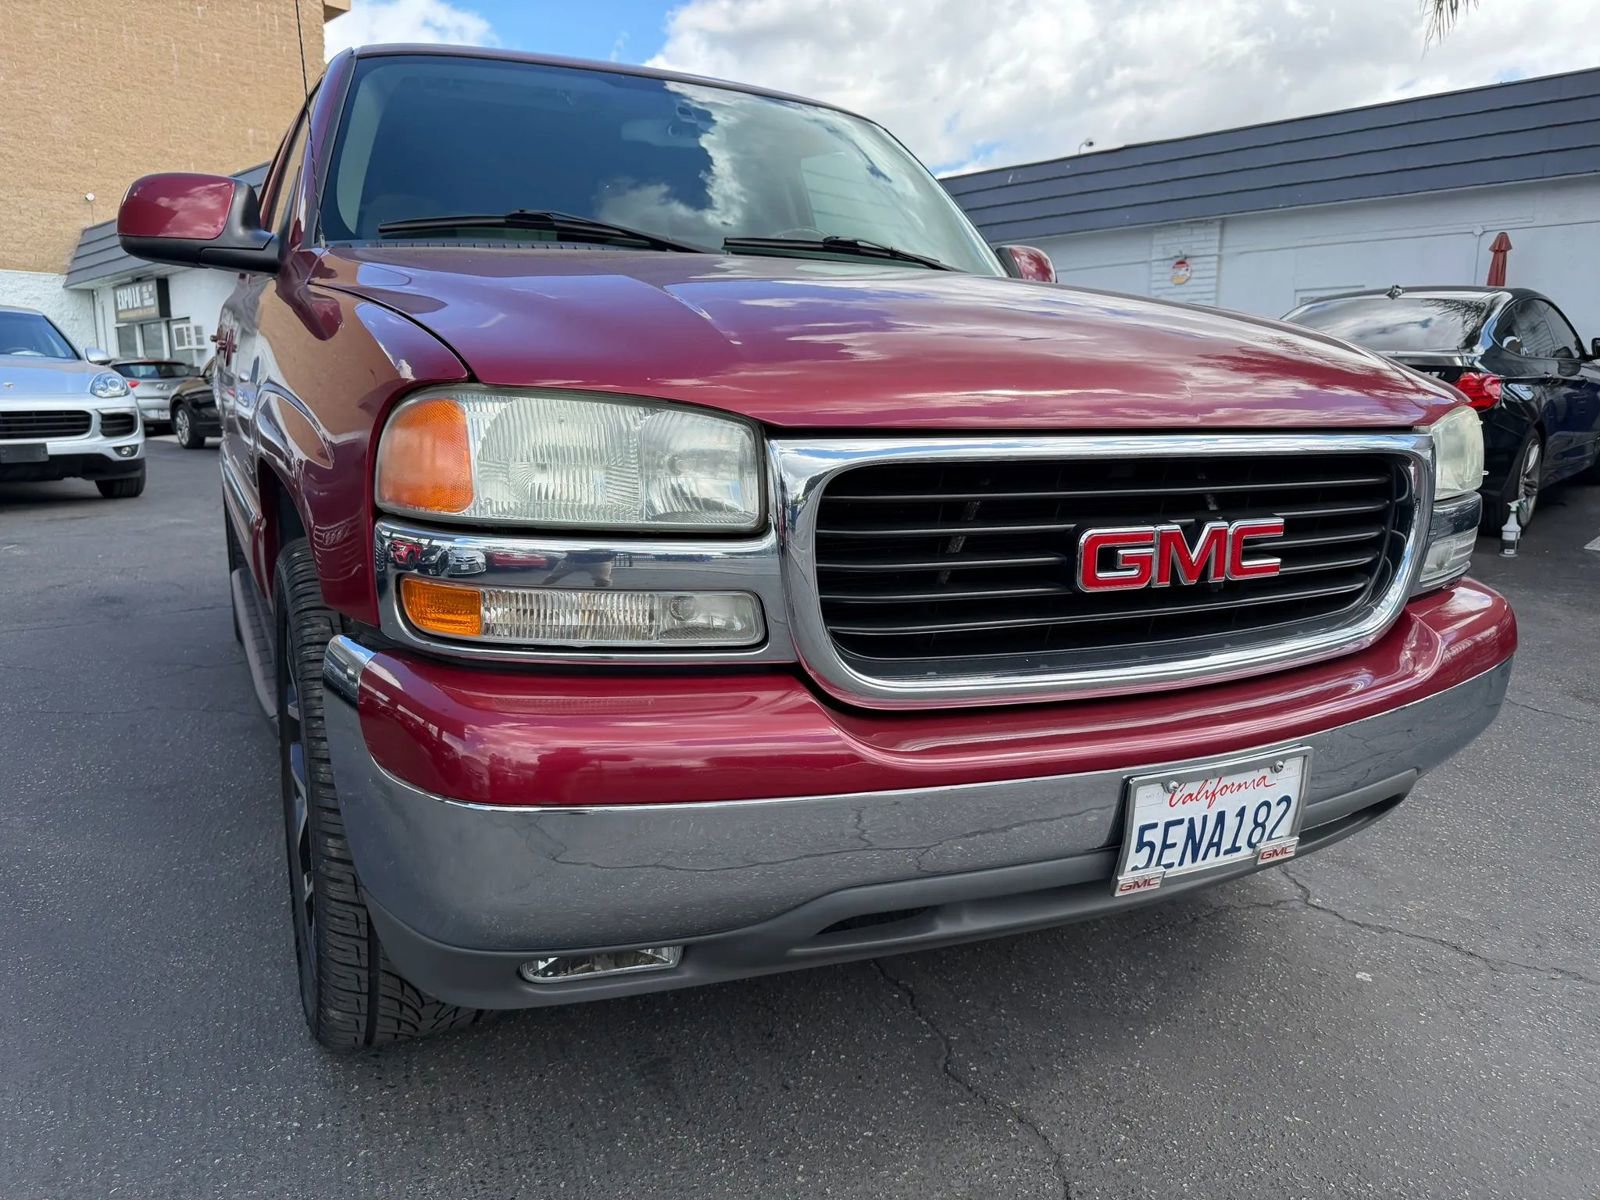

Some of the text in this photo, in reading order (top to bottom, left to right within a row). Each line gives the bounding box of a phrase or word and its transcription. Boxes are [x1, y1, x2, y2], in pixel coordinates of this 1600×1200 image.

[1077, 517, 1284, 592] GMC
[1168, 774, 1277, 809] California
[1130, 795, 1293, 872] 5ENA182
[1260, 844, 1296, 860] GMC
[1118, 876, 1161, 892] GMC
